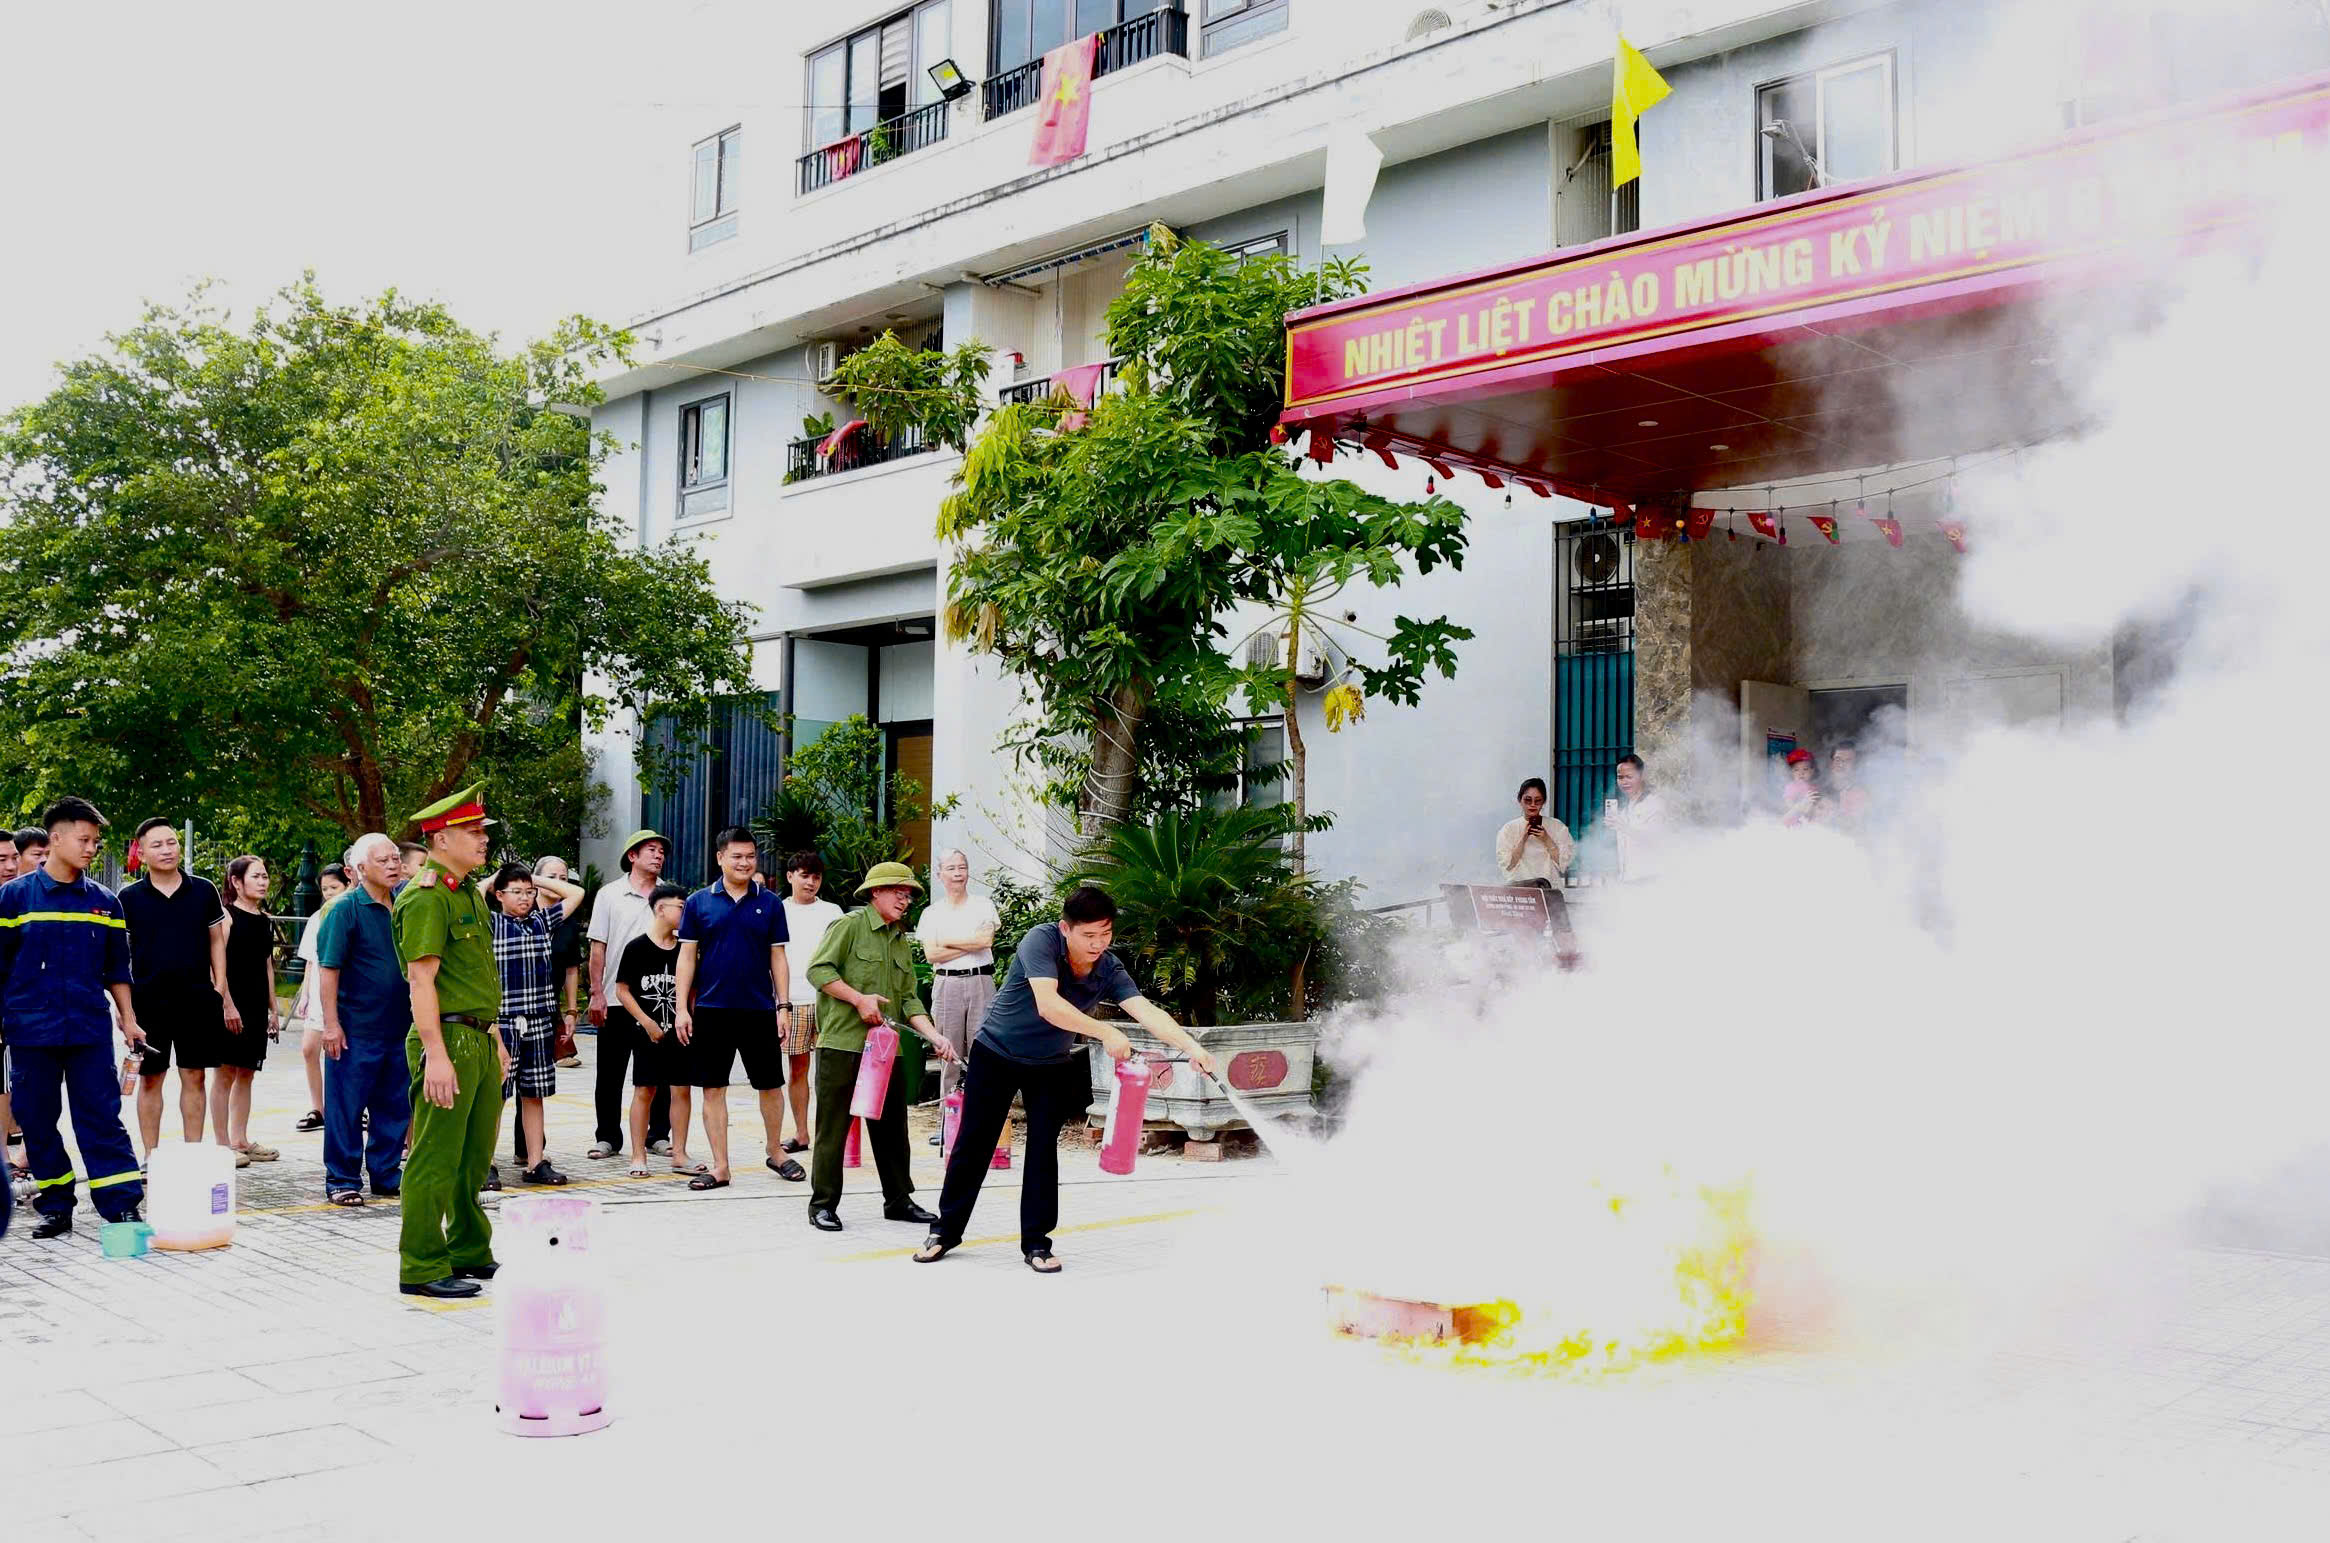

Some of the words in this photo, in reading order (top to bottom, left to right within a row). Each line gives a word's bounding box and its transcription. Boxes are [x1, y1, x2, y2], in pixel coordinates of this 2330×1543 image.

[1344, 317, 1447, 378] NHIỆT
[1458, 295, 1535, 356] LIỆT
[1547, 270, 1659, 335] CHÀO
[1675, 238, 1814, 308] MỪNG
[1829, 206, 1892, 277] KỶ
[1909, 186, 2048, 261] NIỆM
